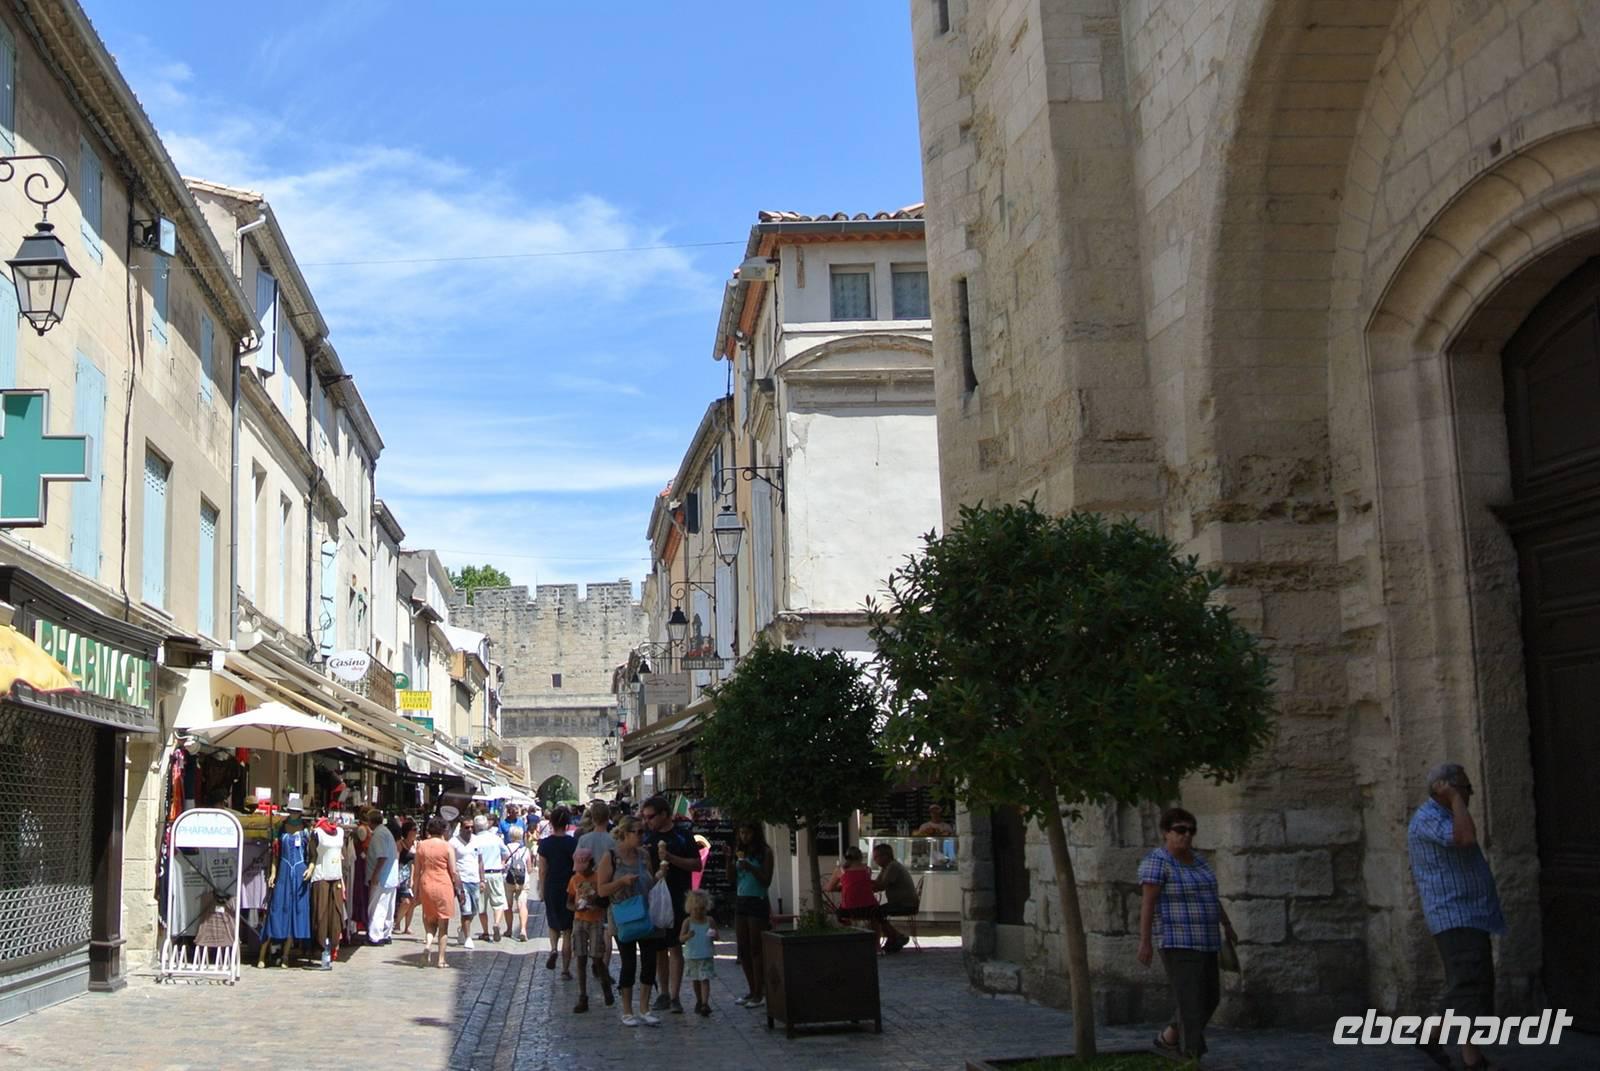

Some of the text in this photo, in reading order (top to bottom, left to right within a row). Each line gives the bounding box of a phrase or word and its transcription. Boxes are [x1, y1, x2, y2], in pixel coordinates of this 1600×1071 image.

[35, 619, 151, 709] PHARMACIE
[329, 657, 366, 669] Casino
[178, 825, 235, 836] PHARMACIE
